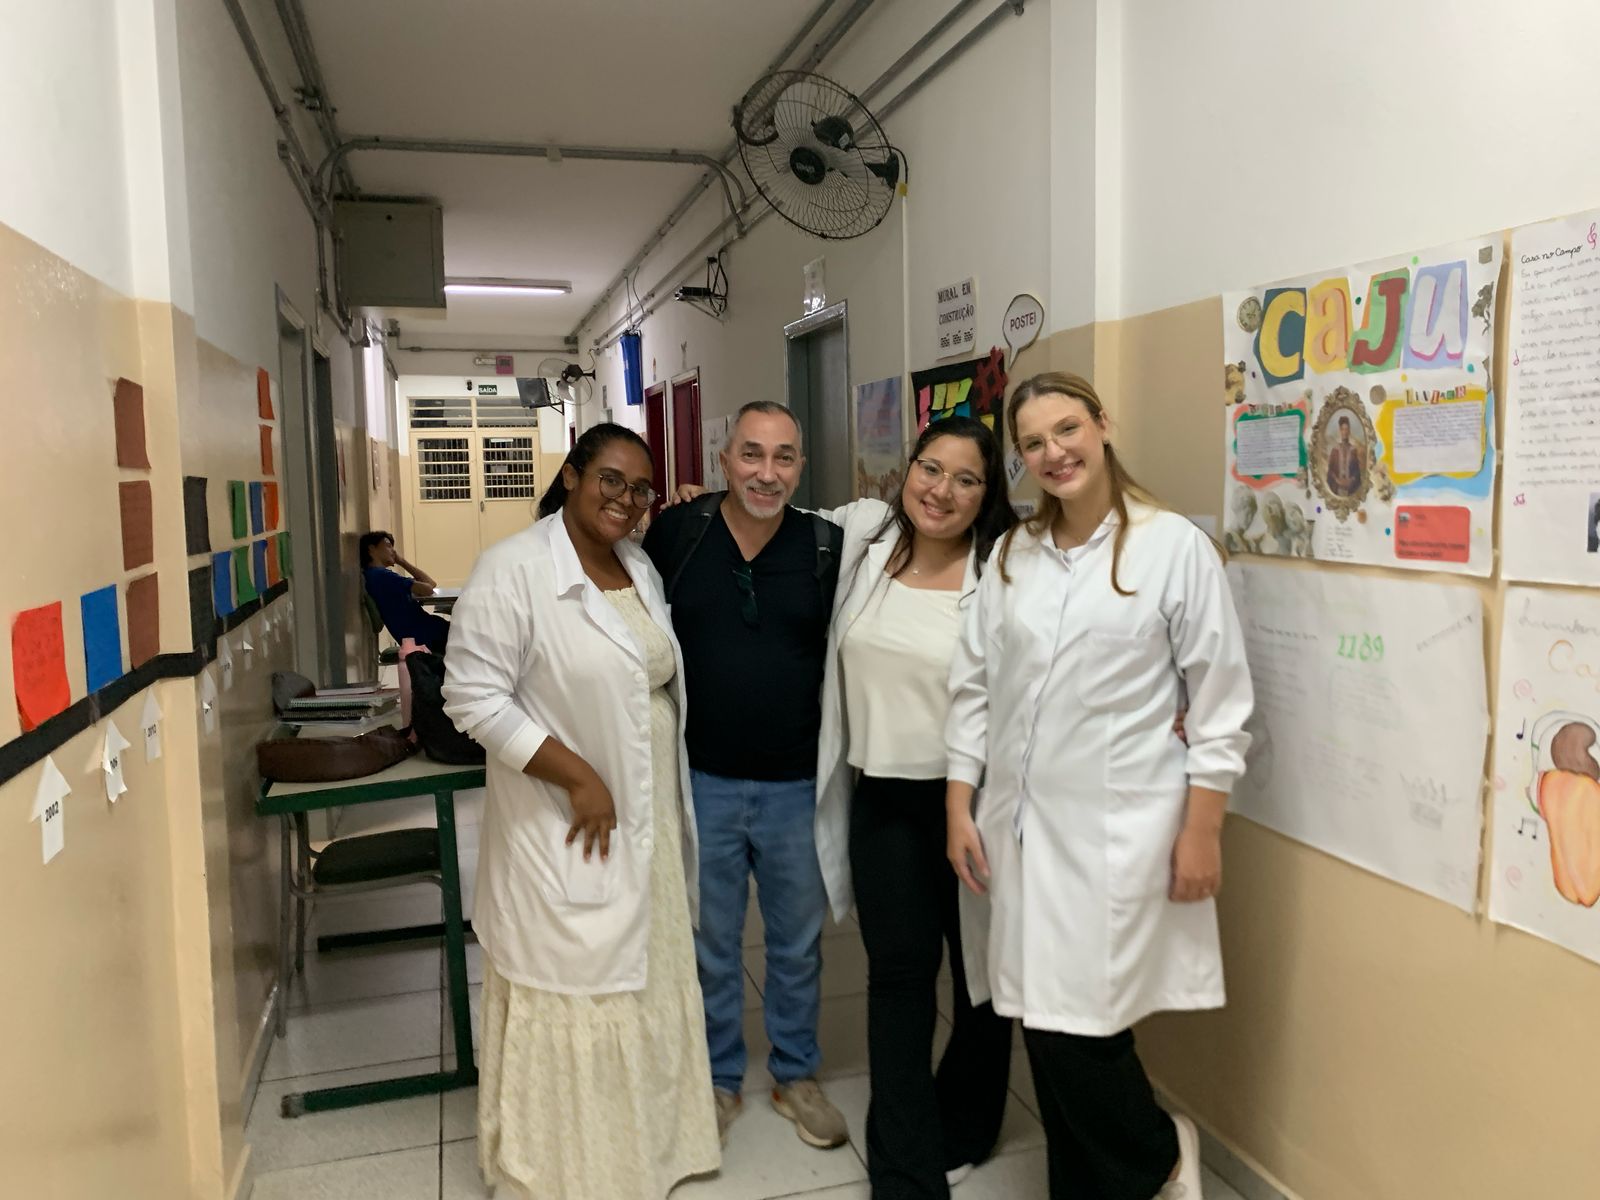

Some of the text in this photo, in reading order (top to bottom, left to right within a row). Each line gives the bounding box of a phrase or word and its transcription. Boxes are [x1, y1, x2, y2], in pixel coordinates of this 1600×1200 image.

[937, 286, 958, 303] MURAL
[938, 304, 974, 325] CONSTRUÇÃO
[1010, 312, 1036, 331] POSTEI
[45, 801, 59, 823] 2002
